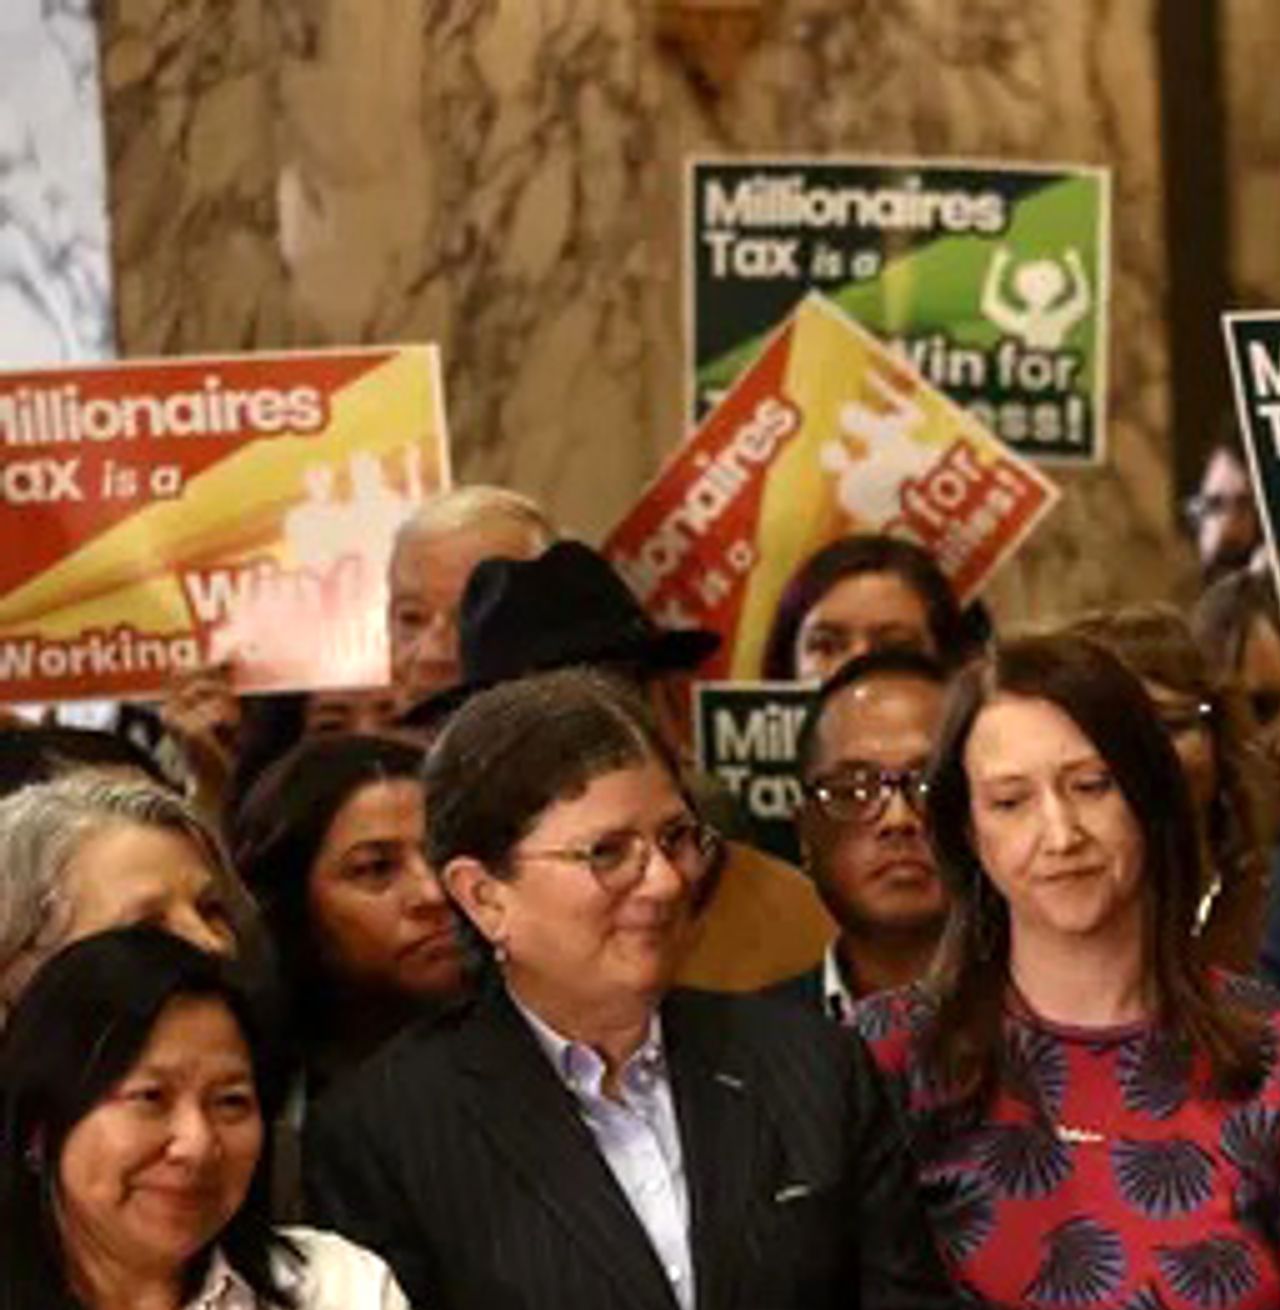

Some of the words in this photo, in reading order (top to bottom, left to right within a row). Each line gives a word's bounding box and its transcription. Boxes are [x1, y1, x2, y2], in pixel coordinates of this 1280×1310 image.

[703, 173, 1004, 232] Millionaires
[704, 230, 798, 278] Tax
[811, 243, 843, 278] is
[850, 249, 881, 279] a
[0, 460, 84, 502] ax
[103, 459, 138, 497] is
[150, 464, 181, 495] a
